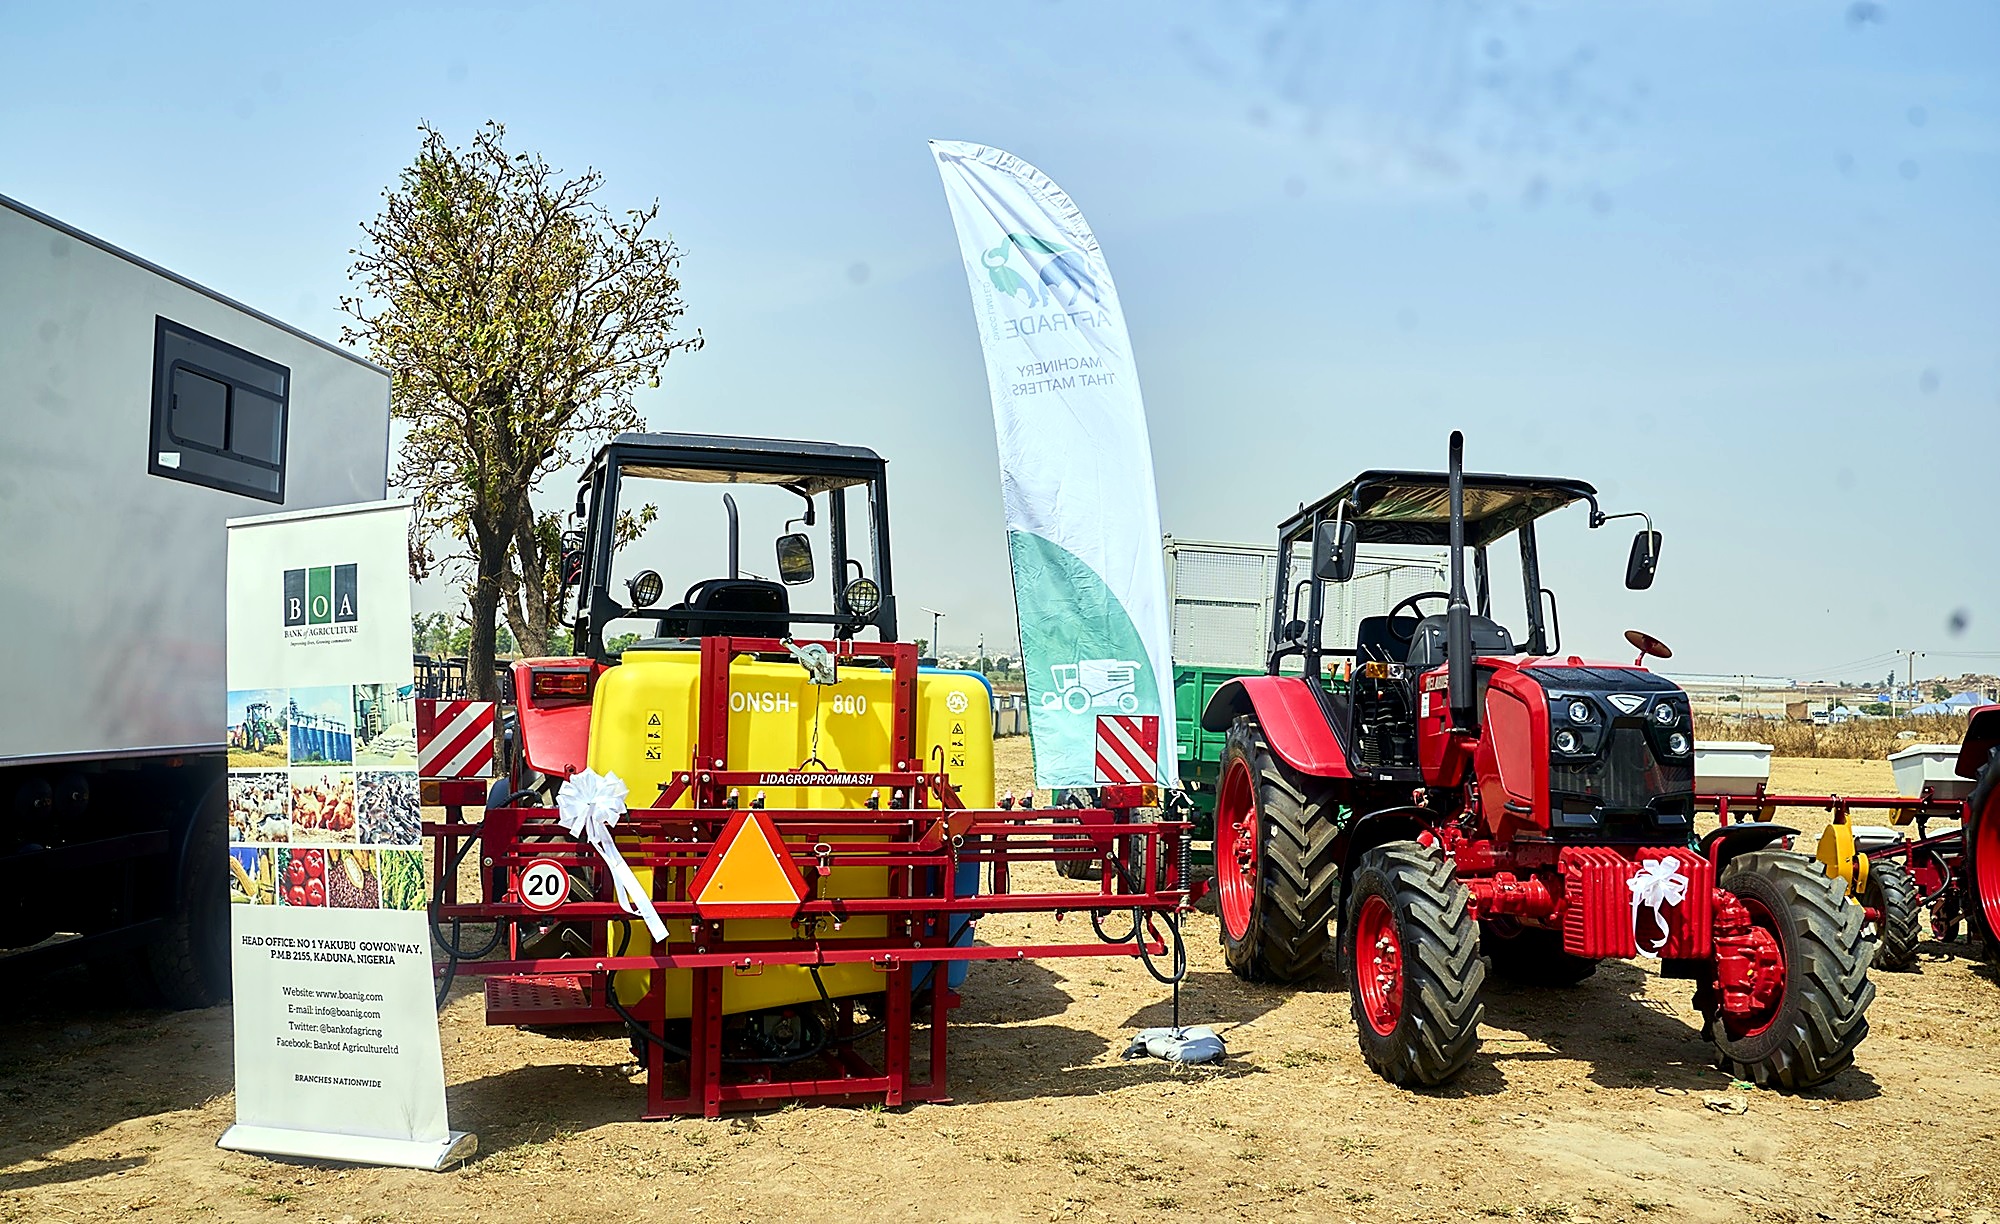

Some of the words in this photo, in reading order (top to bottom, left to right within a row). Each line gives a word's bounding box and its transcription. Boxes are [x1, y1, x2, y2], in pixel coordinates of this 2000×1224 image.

[289, 593, 354, 620] BOA
[284, 629, 302, 638] BANK
[302, 627, 310, 639] of
[308, 625, 358, 637] AGRICULTURE
[832, 694, 867, 715] 800
[759, 773, 874, 785] LIDAGROPROMMASH
[528, 874, 560, 896] 20
[242, 935, 264, 946] HEAD
[265, 937, 296, 948] OFFICE:
[297, 938, 311, 949] NO
[311, 939, 317, 949] 1
[317, 939, 356, 951] YAKUBU
[293, 951, 313, 962] 2155,
[313, 952, 356, 964] KADUNA,
[357, 954, 396, 965] NIGERIA
[282, 986, 315, 998] Website:
[315, 990, 384, 1002] www.boanig.com
[288, 1004, 314, 1015] E-mail:
[315, 1006, 381, 1019] info@boanig.com
[288, 1021, 319, 1032] Twitter:
[319, 1023, 383, 1038] @bankofagricng
[276, 1037, 312, 1049] Facebook:
[313, 1040, 341, 1051] Bankof
[342, 1042, 400, 1055] Agricultureltd
[295, 1074, 332, 1085] BRANCHES
[333, 1077, 382, 1088] NATIONWIDE
